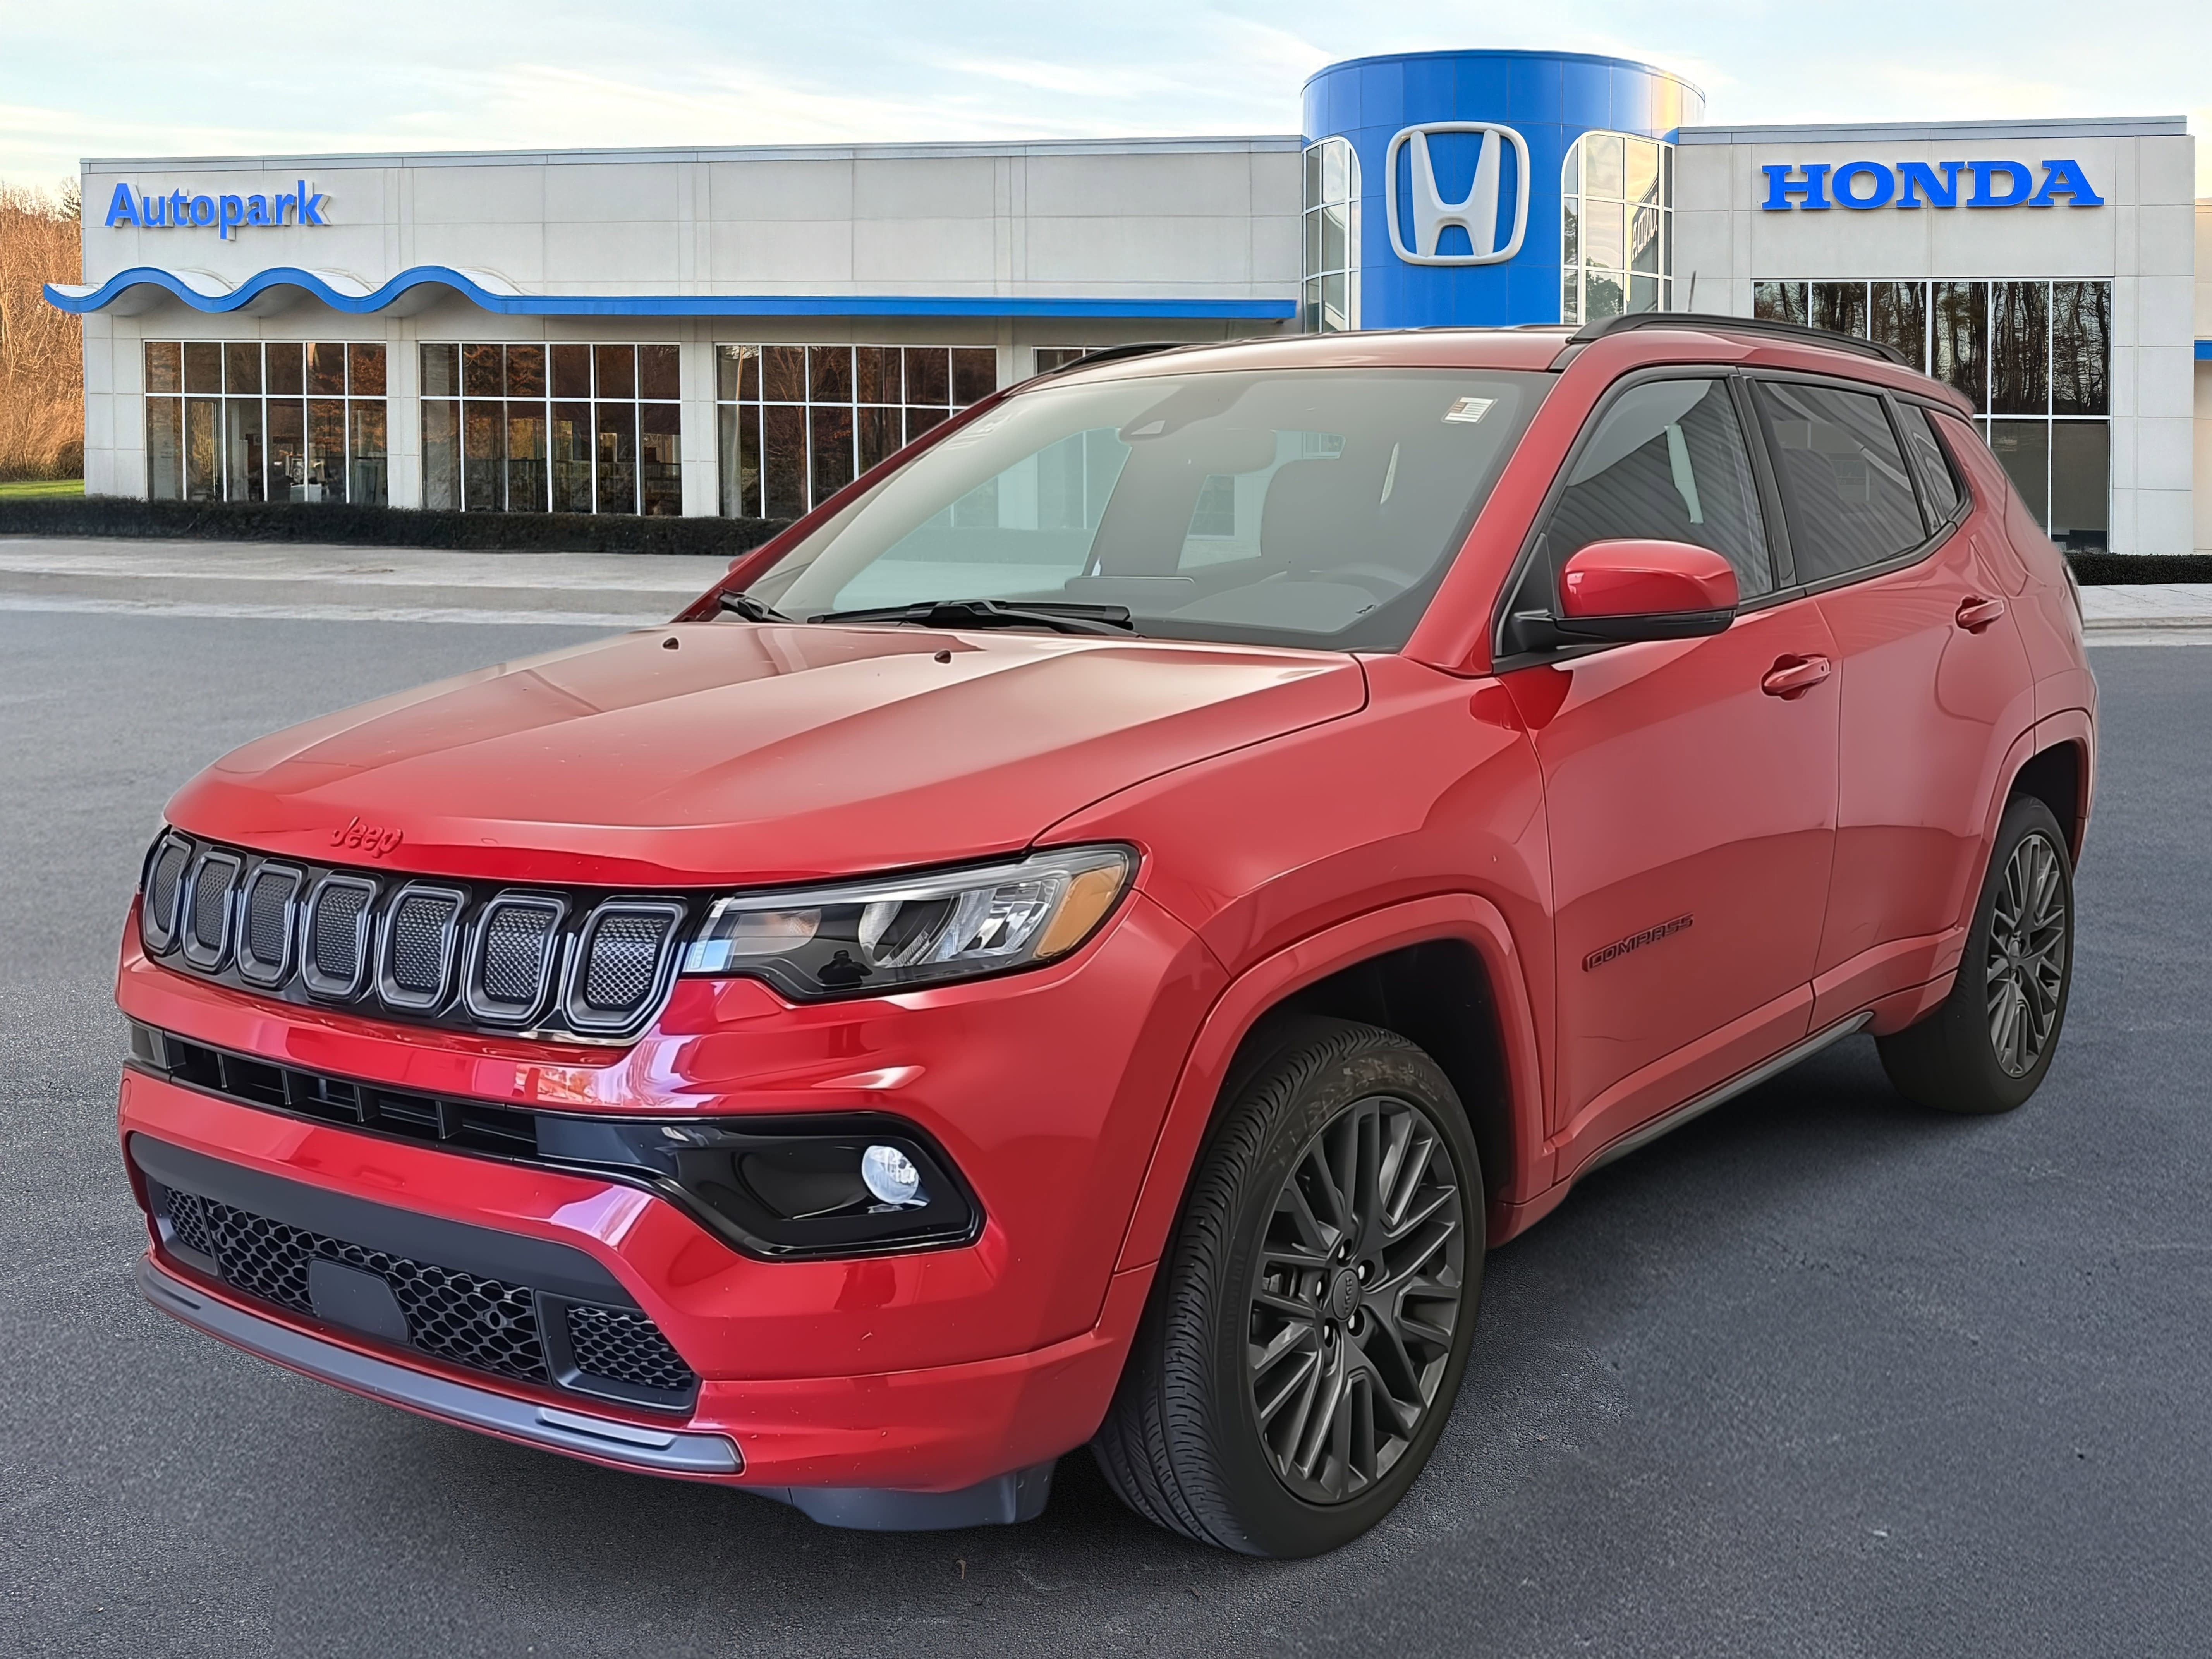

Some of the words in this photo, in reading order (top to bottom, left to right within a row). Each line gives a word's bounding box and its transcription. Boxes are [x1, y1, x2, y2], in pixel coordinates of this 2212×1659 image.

[105, 180, 328, 240] Autopark
[1761, 160, 2104, 210] HONDA
[329, 815, 403, 859] Jeep
[1582, 912, 1694, 972] COMPASS
